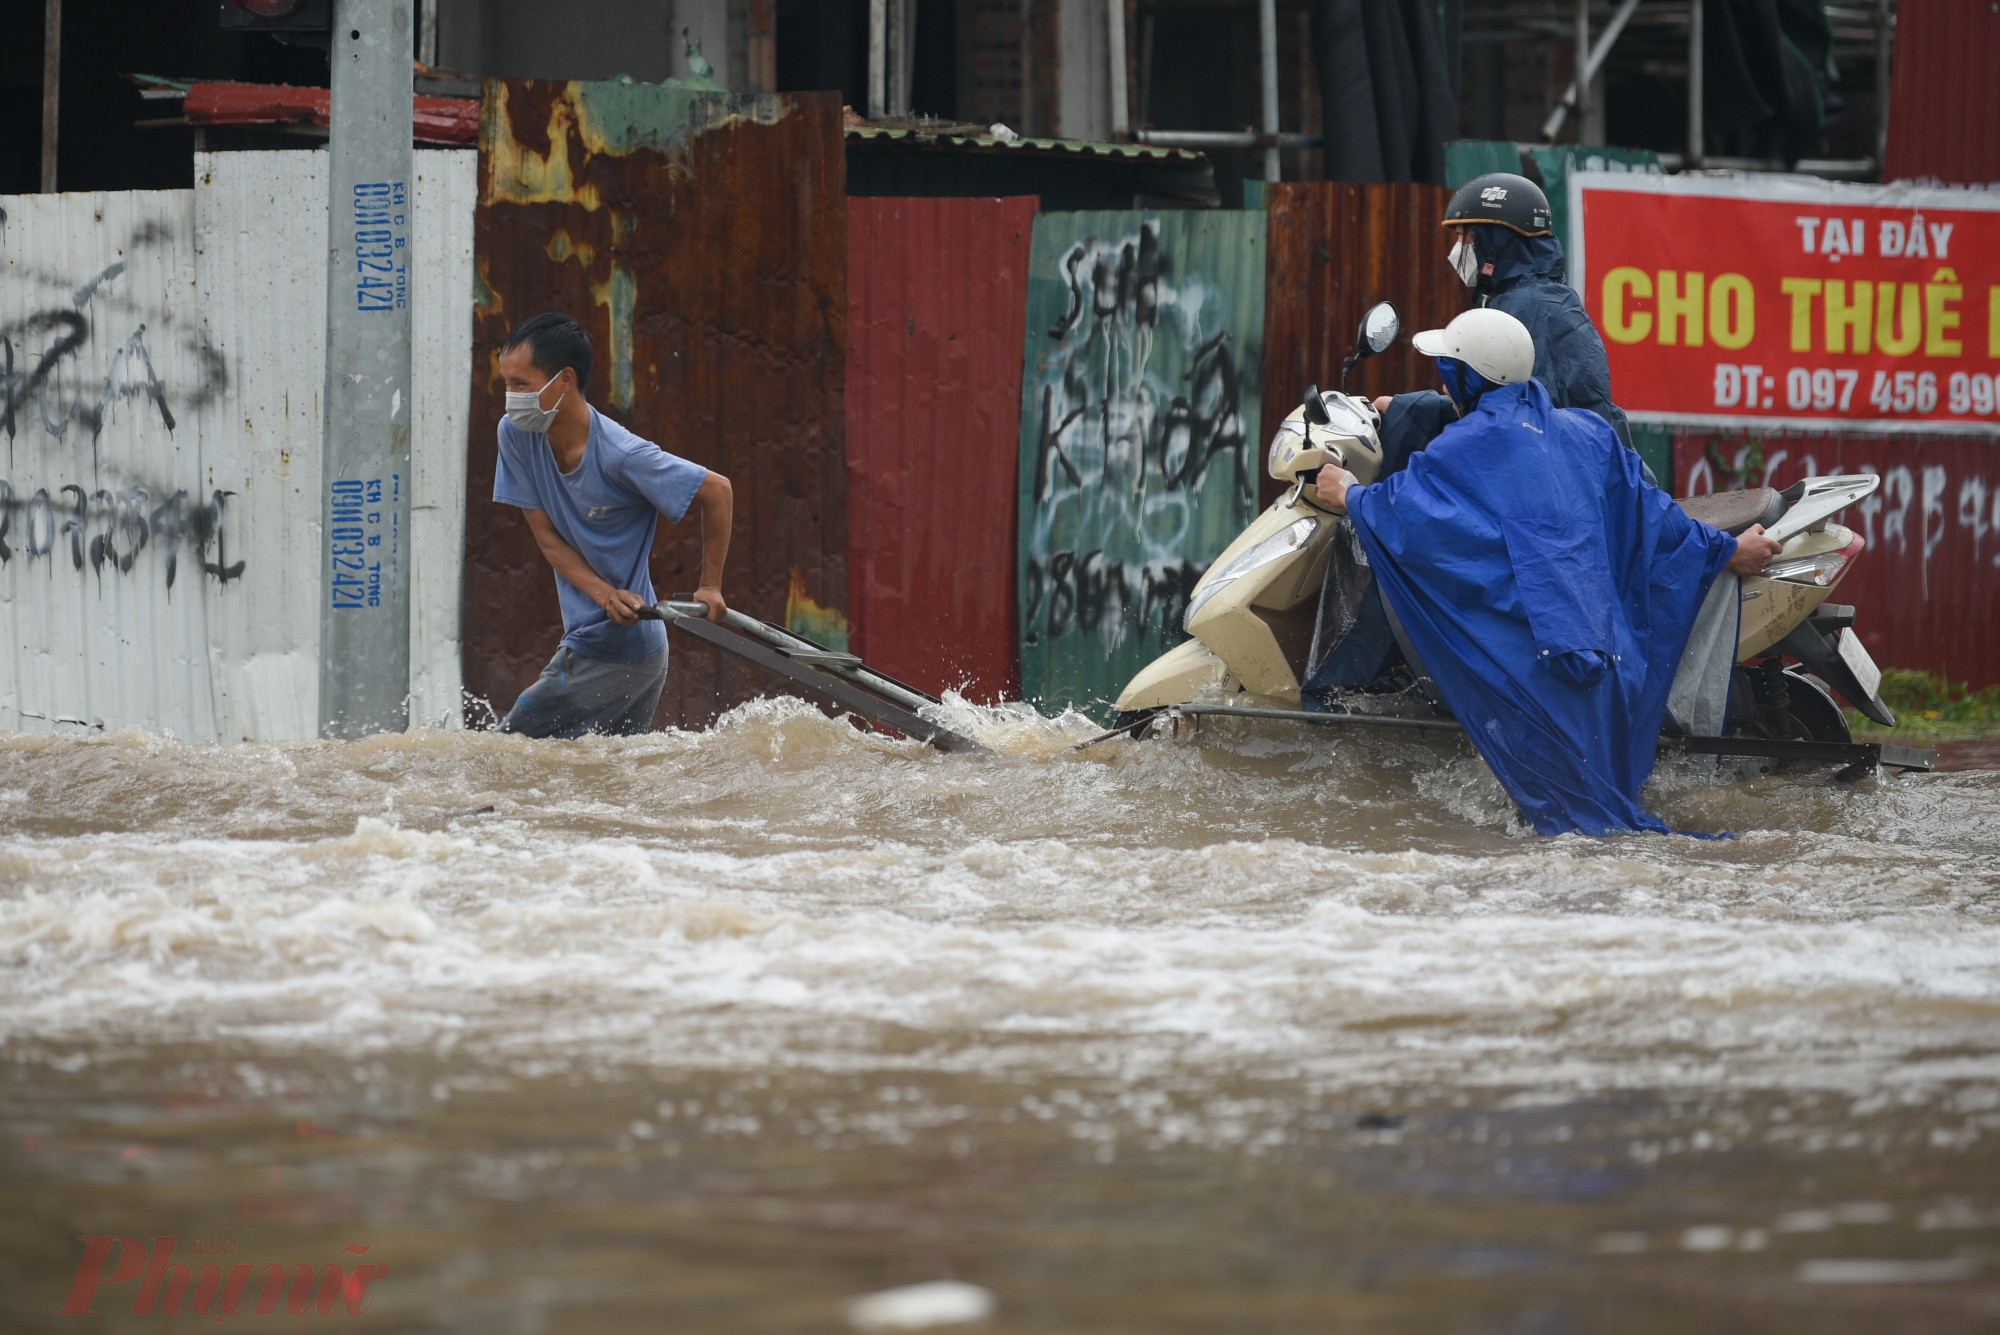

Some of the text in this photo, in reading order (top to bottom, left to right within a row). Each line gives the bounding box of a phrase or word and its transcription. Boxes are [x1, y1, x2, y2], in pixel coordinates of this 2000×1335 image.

[393, 182, 404, 205] KH
[1480, 186, 1508, 201] FPT
[1481, 201, 1502, 209] Telecom
[1796, 214, 1954, 262] TẠI ĐÂY
[1602, 266, 1755, 349] CHO
[1781, 266, 1963, 358] THUÊ
[1714, 363, 1775, 409] ĐT:
[1787, 367, 1858, 412] 097
[1870, 371, 1938, 414] 456
[366, 479, 381, 503] KH
[331, 480, 365, 609] 0911032421
